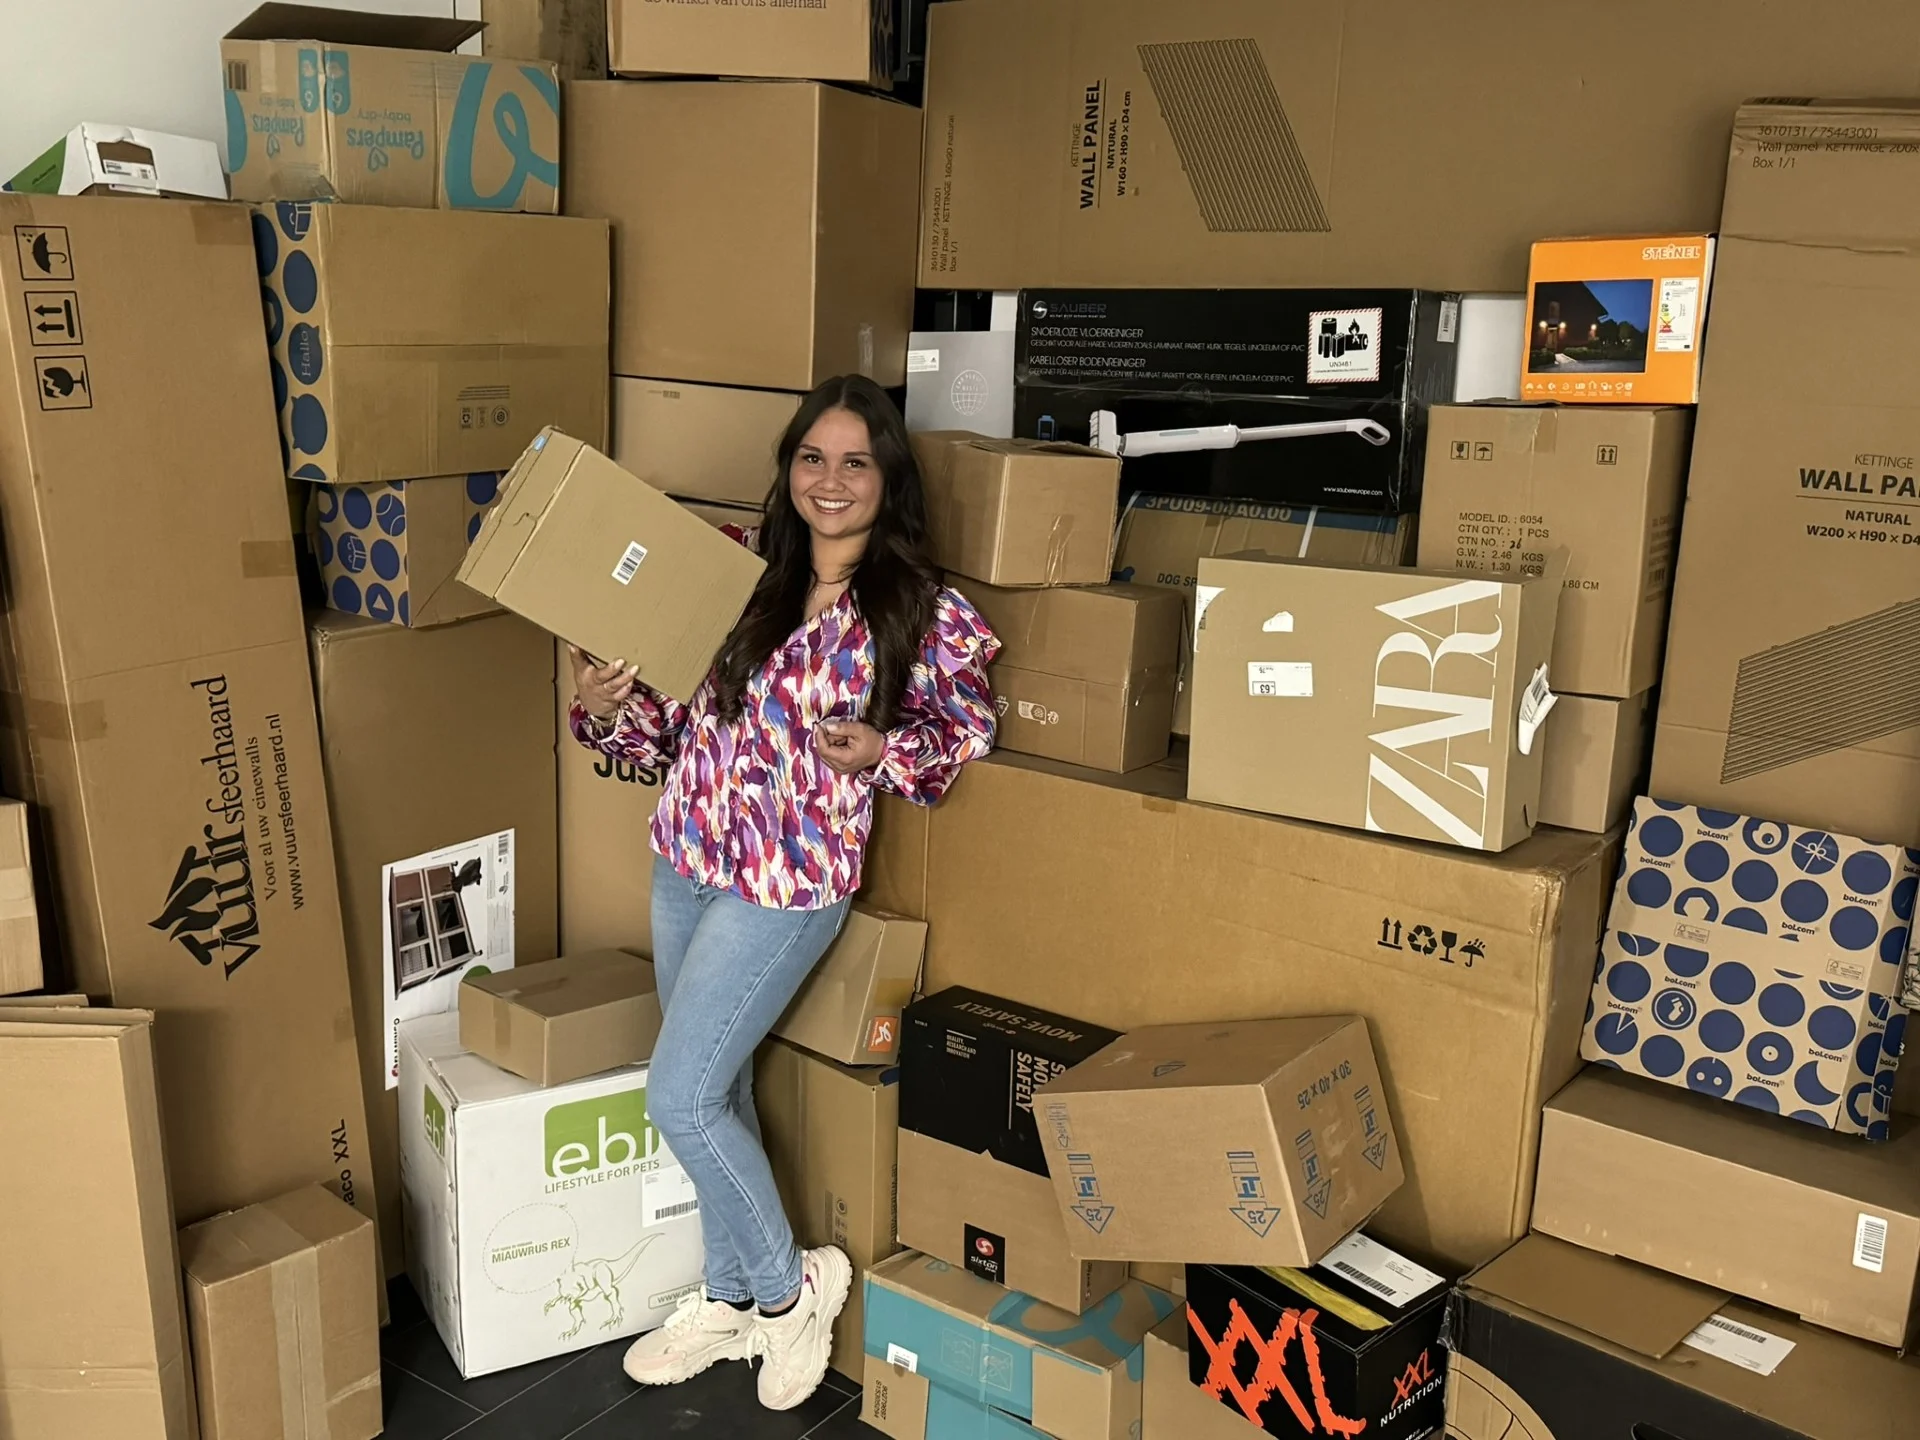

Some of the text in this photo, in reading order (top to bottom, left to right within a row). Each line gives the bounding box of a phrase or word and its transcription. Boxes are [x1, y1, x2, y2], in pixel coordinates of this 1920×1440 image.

[1124, 91, 1131, 106] cm
[1122, 108, 1130, 123] D4
[252, 114, 305, 147] Pampers
[1757, 125, 1807, 137] 3610131
[1819, 127, 1879, 139] 75443001
[346, 126, 425, 160] Pampers
[1070, 123, 1081, 168] KETTINGE
[1080, 80, 1100, 209] WALL PANEL
[1107, 119, 1117, 169] NATURAL
[1120, 134, 1128, 155] H90
[1756, 141, 1920, 153] Wall panel KETTINGE 200x
[1752, 156, 1795, 169] Box 1/1
[1117, 166, 1126, 196] W160
[939, 253, 947, 272] Wall
[943, 181, 951, 222] KETTINGE
[1050, 303, 1107, 313] SAUBER
[1031, 326, 1144, 338] SNOERLOZE VLOERREINIGER
[1030, 355, 1146, 368] KABELLOSER BODENREINIGER
[1854, 454, 1914, 470] KETTINGE
[1799, 468, 1920, 498] WALL PA
[1459, 512, 1494, 523] MODEL
[1519, 514, 1543, 524] 6054
[1845, 509, 1912, 526] NATURAL
[1458, 524, 1479, 533] CTN
[1527, 528, 1549, 538] PCS
[1806, 525, 1845, 538] W200
[1859, 530, 1887, 542] H90
[1457, 536, 1478, 546] CTN
[1491, 550, 1512, 559] 2.46
[1521, 552, 1544, 562] KGS
[1491, 562, 1511, 572] 1.30
[1519, 564, 1543, 574] KGS
[1157, 572, 1197, 587] DOG SP
[1582, 580, 1599, 590] CM
[1259, 684, 1271, 694] 63
[1365, 580, 1502, 850] ZARA
[245, 736, 278, 901] Voor al uw cinewalls
[265, 713, 304, 911] www.vuursfeerhaard.nl
[953, 1001, 1027, 1025] SAFELY
[1022, 1020, 1083, 1042] MOVE
[1339, 1059, 1352, 1079] 30
[1015, 1051, 1034, 1113] SAFELY
[1319, 1076, 1332, 1094] 40
[1297, 1089, 1311, 1110] 25
[425, 1109, 444, 1157] ebi
[552, 1112, 652, 1178] ebi
[1371, 1142, 1382, 1160] 25
[331, 1118, 356, 1206] aco XXL
[544, 1171, 605, 1194] LIFESTYLE
[607, 1166, 630, 1181] FOR
[633, 1159, 661, 1174] PETS
[1313, 1193, 1326, 1209] 25
[1086, 1208, 1102, 1222] 25
[1247, 1210, 1267, 1224] 25
[492, 1242, 549, 1264] MIAUWRUS
[551, 1237, 571, 1250] REX
[970, 1255, 998, 1271] sixton
[1187, 1298, 1367, 1440] XXL
[1391, 1348, 1435, 1410] XXL
[1380, 1375, 1443, 1427] NUTRITION
